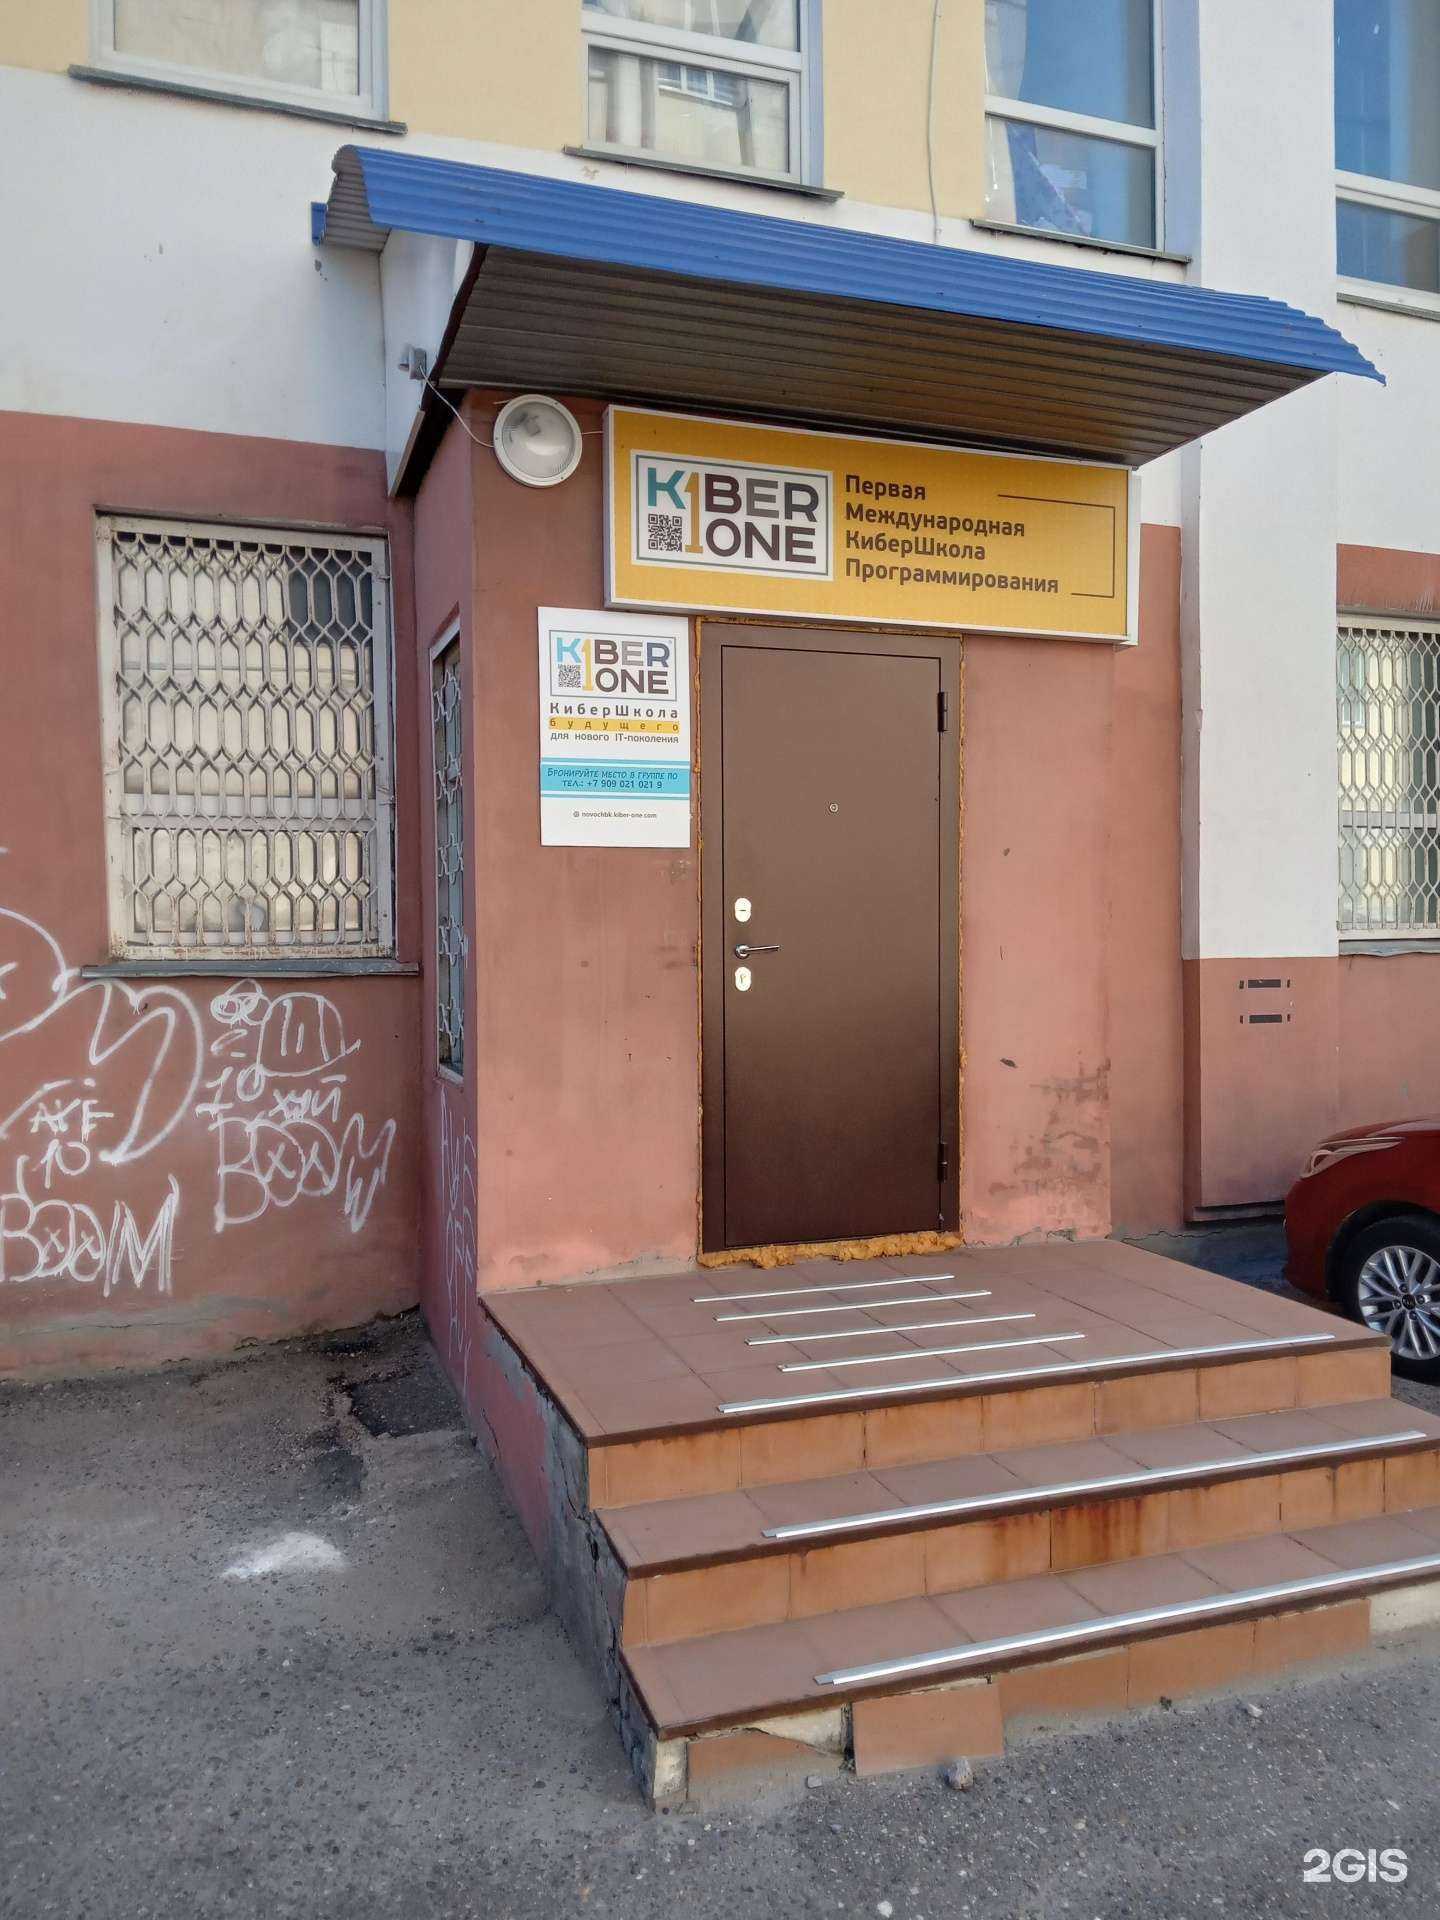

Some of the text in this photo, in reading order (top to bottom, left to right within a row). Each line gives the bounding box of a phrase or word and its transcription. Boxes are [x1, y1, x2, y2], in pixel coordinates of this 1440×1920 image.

[845, 474, 926, 500] Первая
[845, 502, 1025, 537] Международная
[705, 518, 817, 564] ONE
[845, 530, 986, 560] КиберШкола
[845, 558, 1059, 594] Программирования
[595, 667, 669, 695] ONE
[550, 732, 679, 744] для нового IT-поколения
[587, 779, 598, 788] +7
[601, 780, 617, 788] 909
[619, 780, 634, 789] 021
[638, 780, 653, 789] 021
[656, 781, 663, 789] 9
